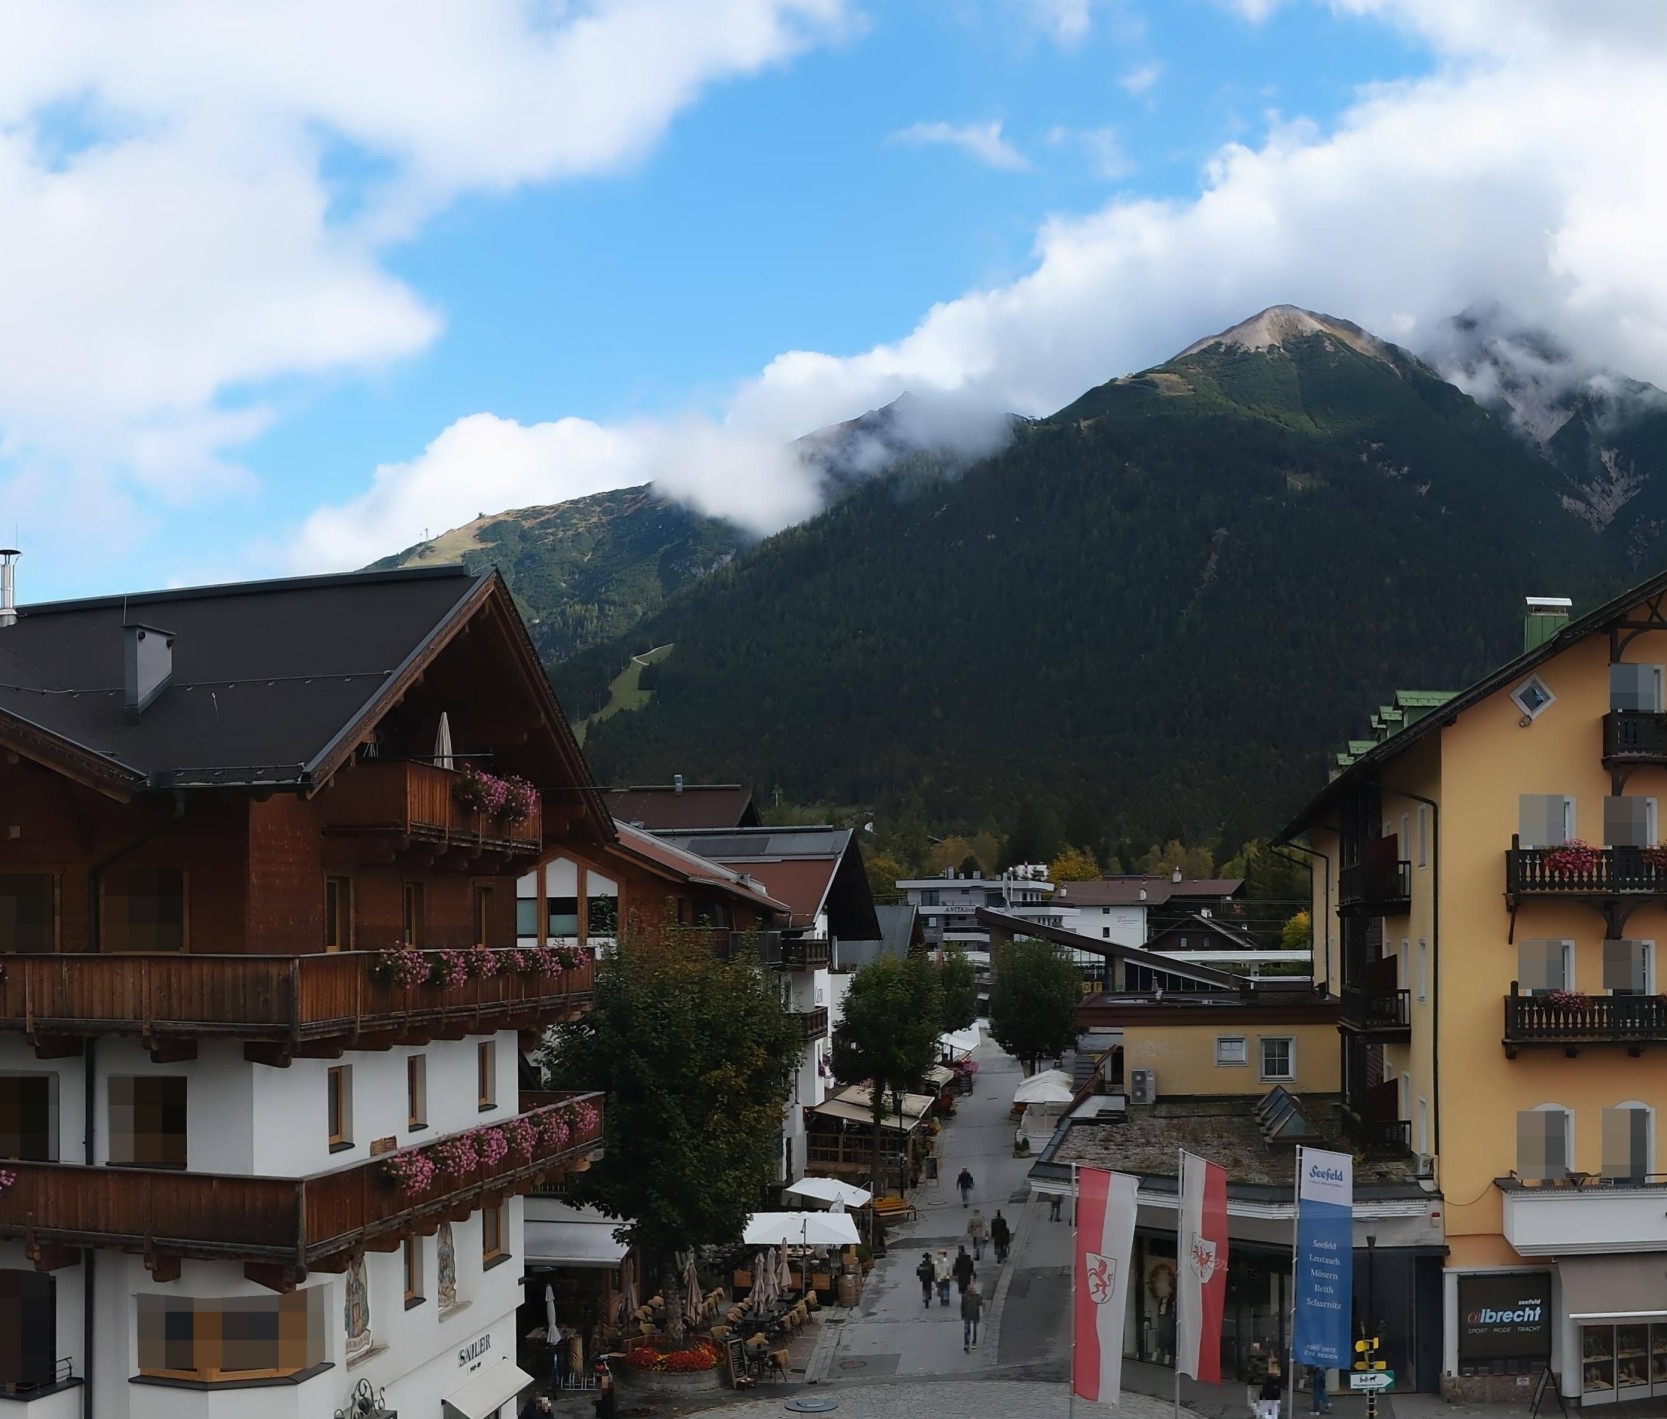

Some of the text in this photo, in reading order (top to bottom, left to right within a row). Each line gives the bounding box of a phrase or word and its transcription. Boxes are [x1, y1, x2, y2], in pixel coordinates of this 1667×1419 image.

[1309, 1165, 1343, 1181] Seefeld
[1312, 1239, 1337, 1251] Seefeld
[1309, 1254, 1341, 1266] Leutasch
[1310, 1268, 1338, 1280] Mösern
[1314, 1284, 1334, 1294] Reith
[1306, 1298, 1342, 1310] Scharnitz
[458, 1333, 491, 1368] SAILER
